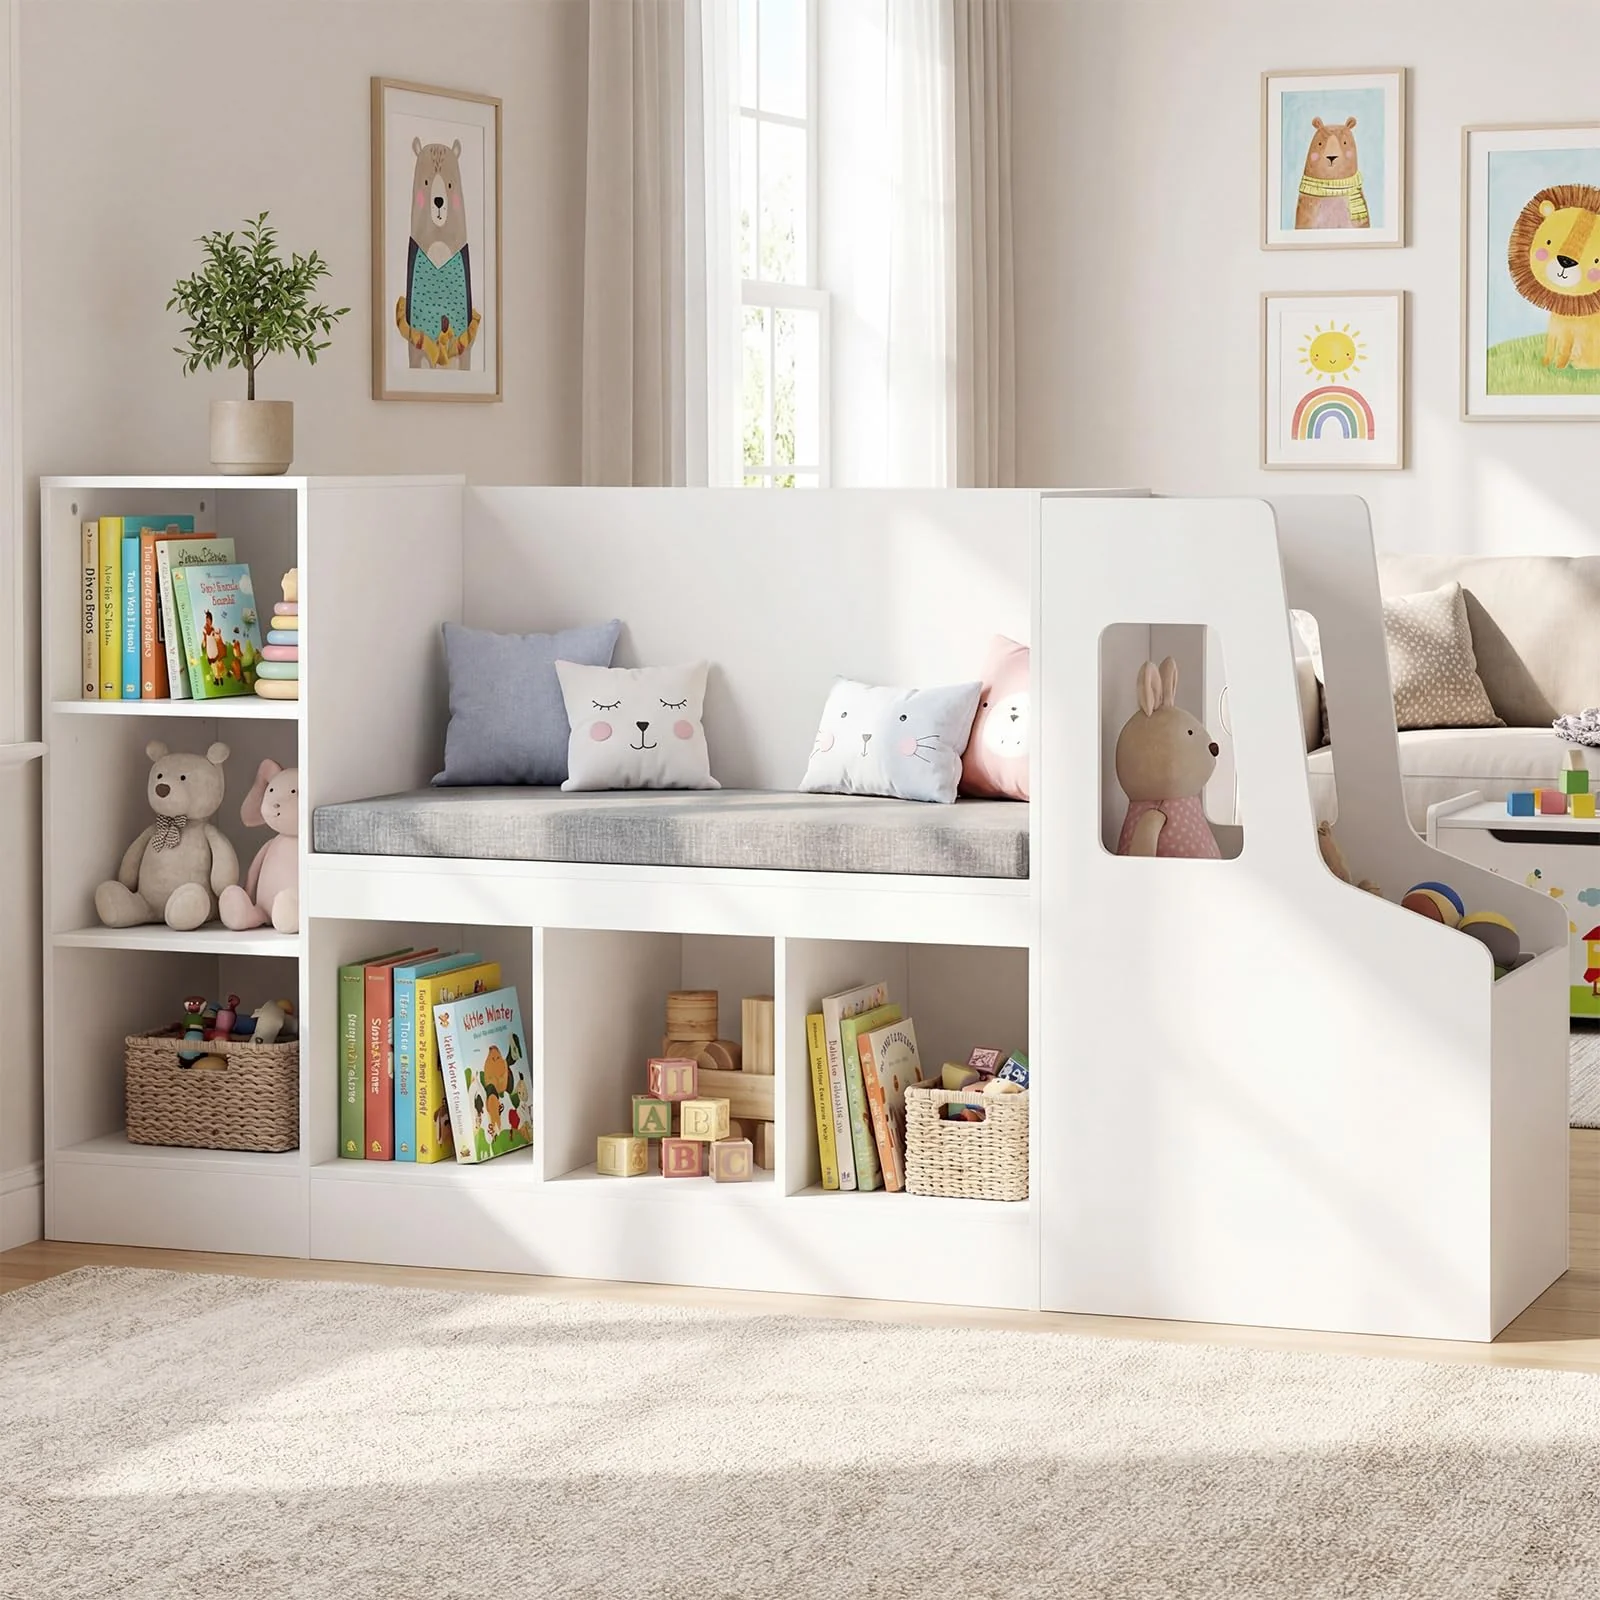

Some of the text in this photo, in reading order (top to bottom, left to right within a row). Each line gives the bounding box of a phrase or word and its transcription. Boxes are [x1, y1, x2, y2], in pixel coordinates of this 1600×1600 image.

[640, 1105, 666, 1131] A
[690, 1108, 710, 1134] B
[671, 1146, 696, 1171] B
[721, 1150, 746, 1176] C
